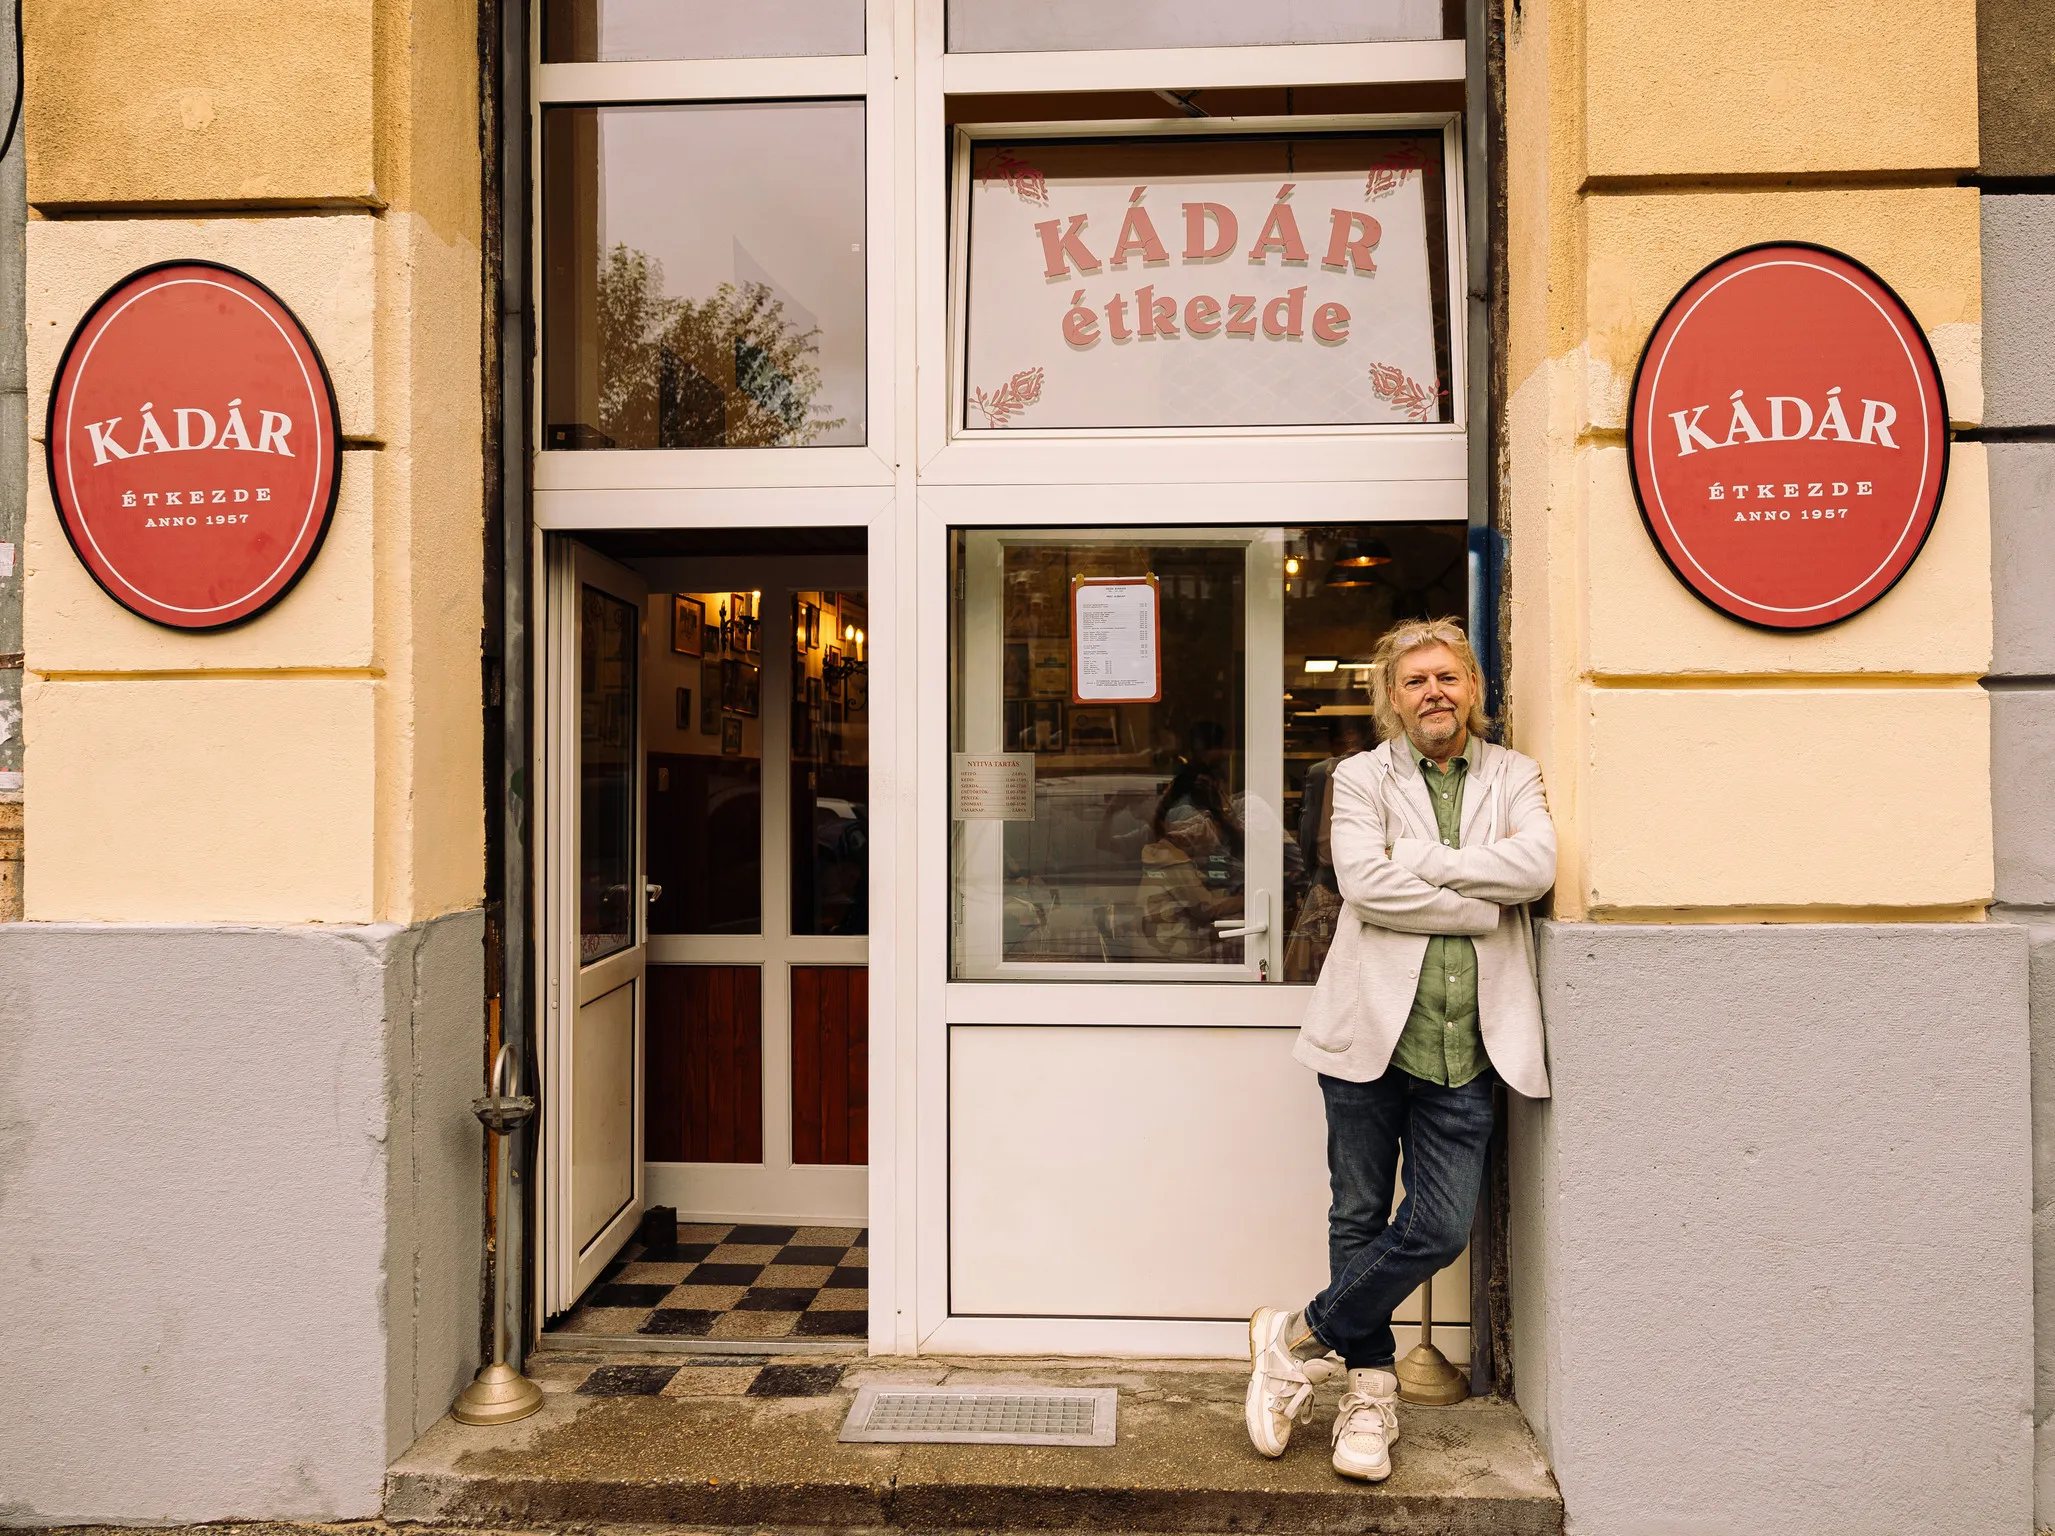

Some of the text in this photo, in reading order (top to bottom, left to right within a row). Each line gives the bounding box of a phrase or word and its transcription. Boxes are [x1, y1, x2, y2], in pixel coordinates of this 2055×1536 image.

[1033, 183, 1384, 277] KÁDÁR
[1061, 284, 1351, 345] étkezde
[84, 397, 296, 467] KÁDÁR
[1667, 386, 1901, 457] KÁDÁR
[121, 487, 271, 508] ÉTKEZDE
[1708, 481, 1873, 500] ÉTKEZDE
[145, 513, 249, 528] ANNO 1957
[1733, 508, 1849, 522] ANNO 1957
